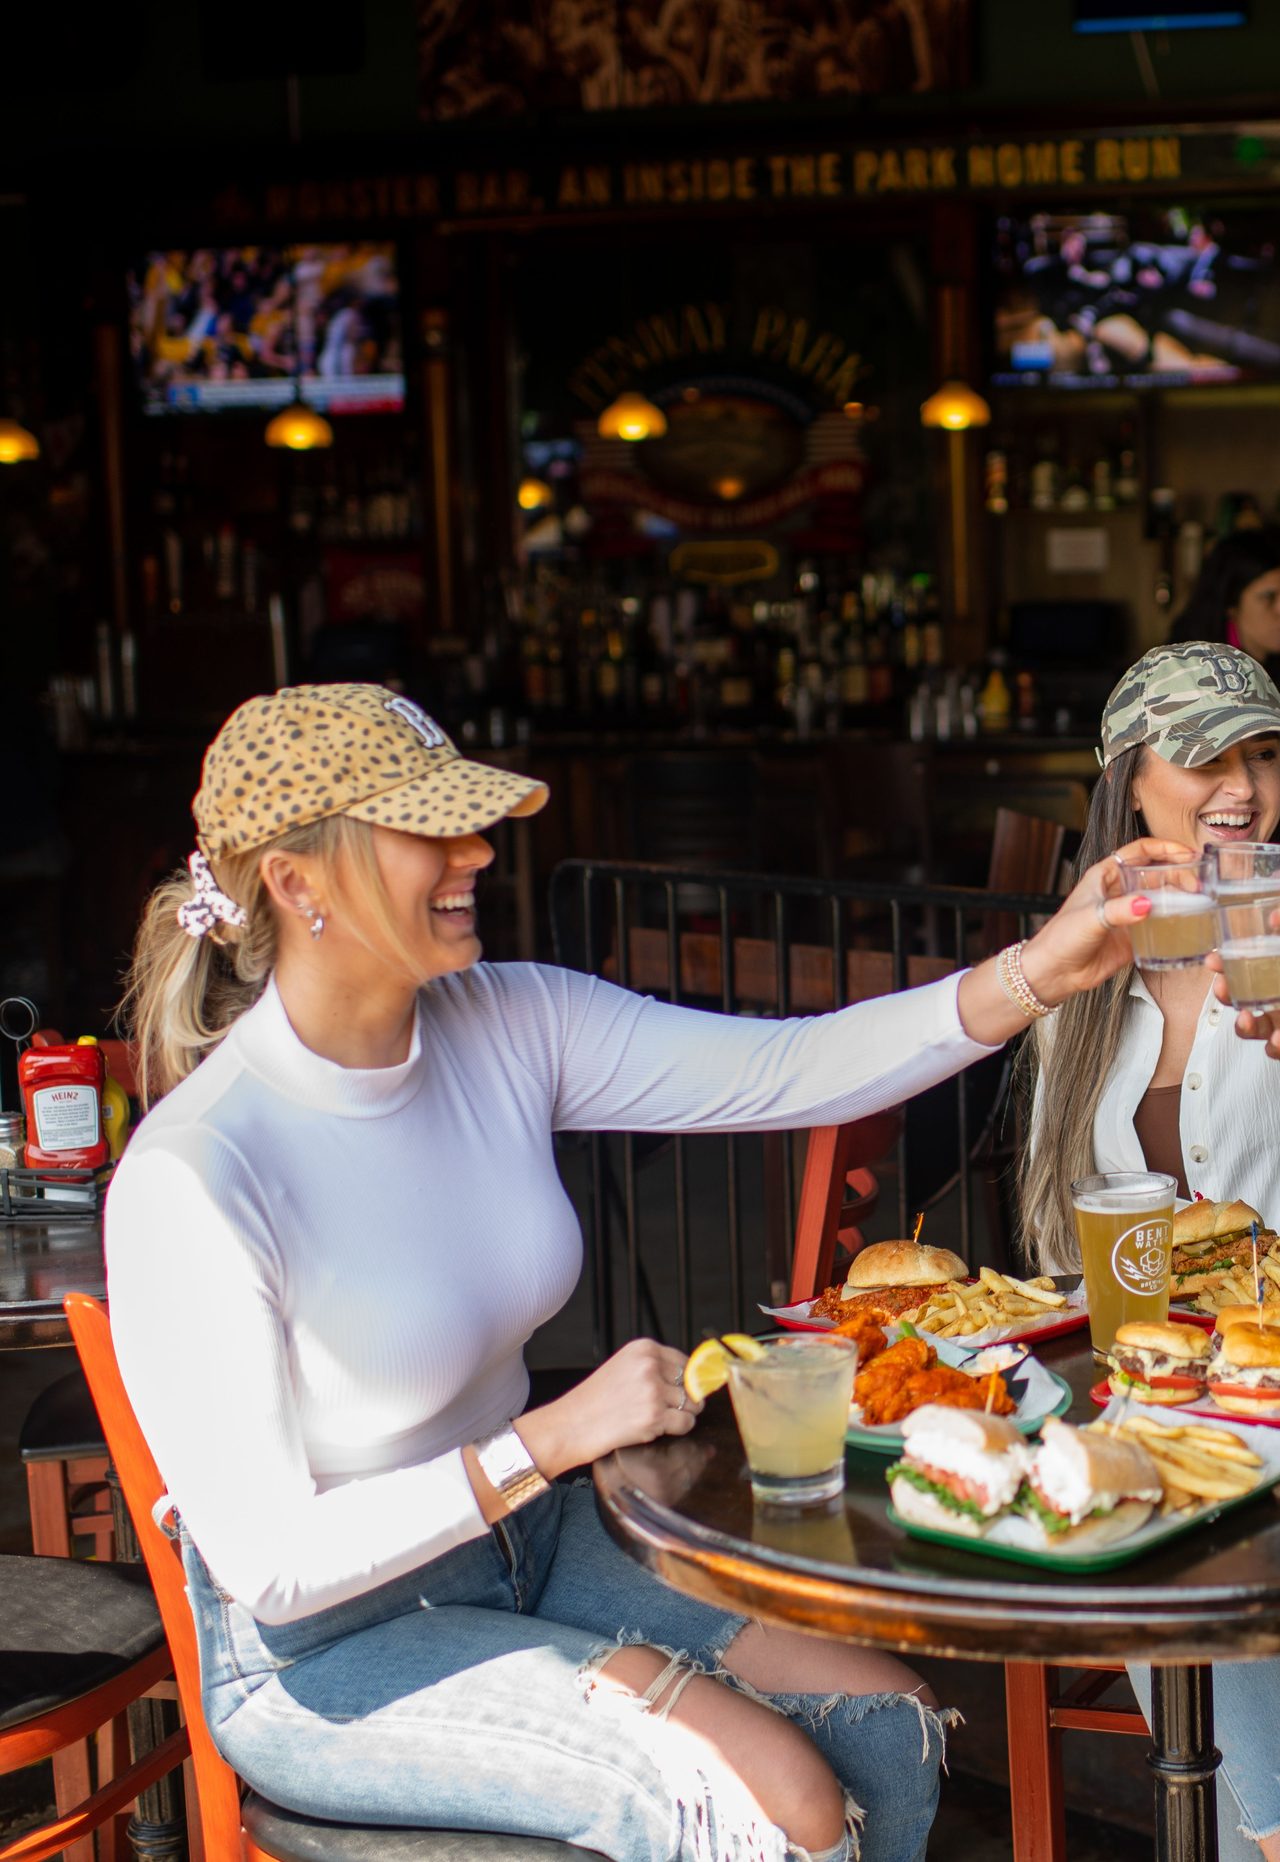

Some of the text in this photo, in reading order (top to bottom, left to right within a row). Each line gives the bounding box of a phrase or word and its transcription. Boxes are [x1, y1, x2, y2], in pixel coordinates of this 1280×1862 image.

[557, 163, 611, 206] AN
[622, 155, 761, 206] INSIDE
[767, 150, 840, 197] THE
[852, 145, 958, 193] PARK
[966, 138, 1084, 188] HOME
[1094, 135, 1182, 182] RUN
[1201, 654, 1248, 696] B
[51, 1091, 79, 1102] HEINZ
[1136, 1225, 1169, 1242] BENT
